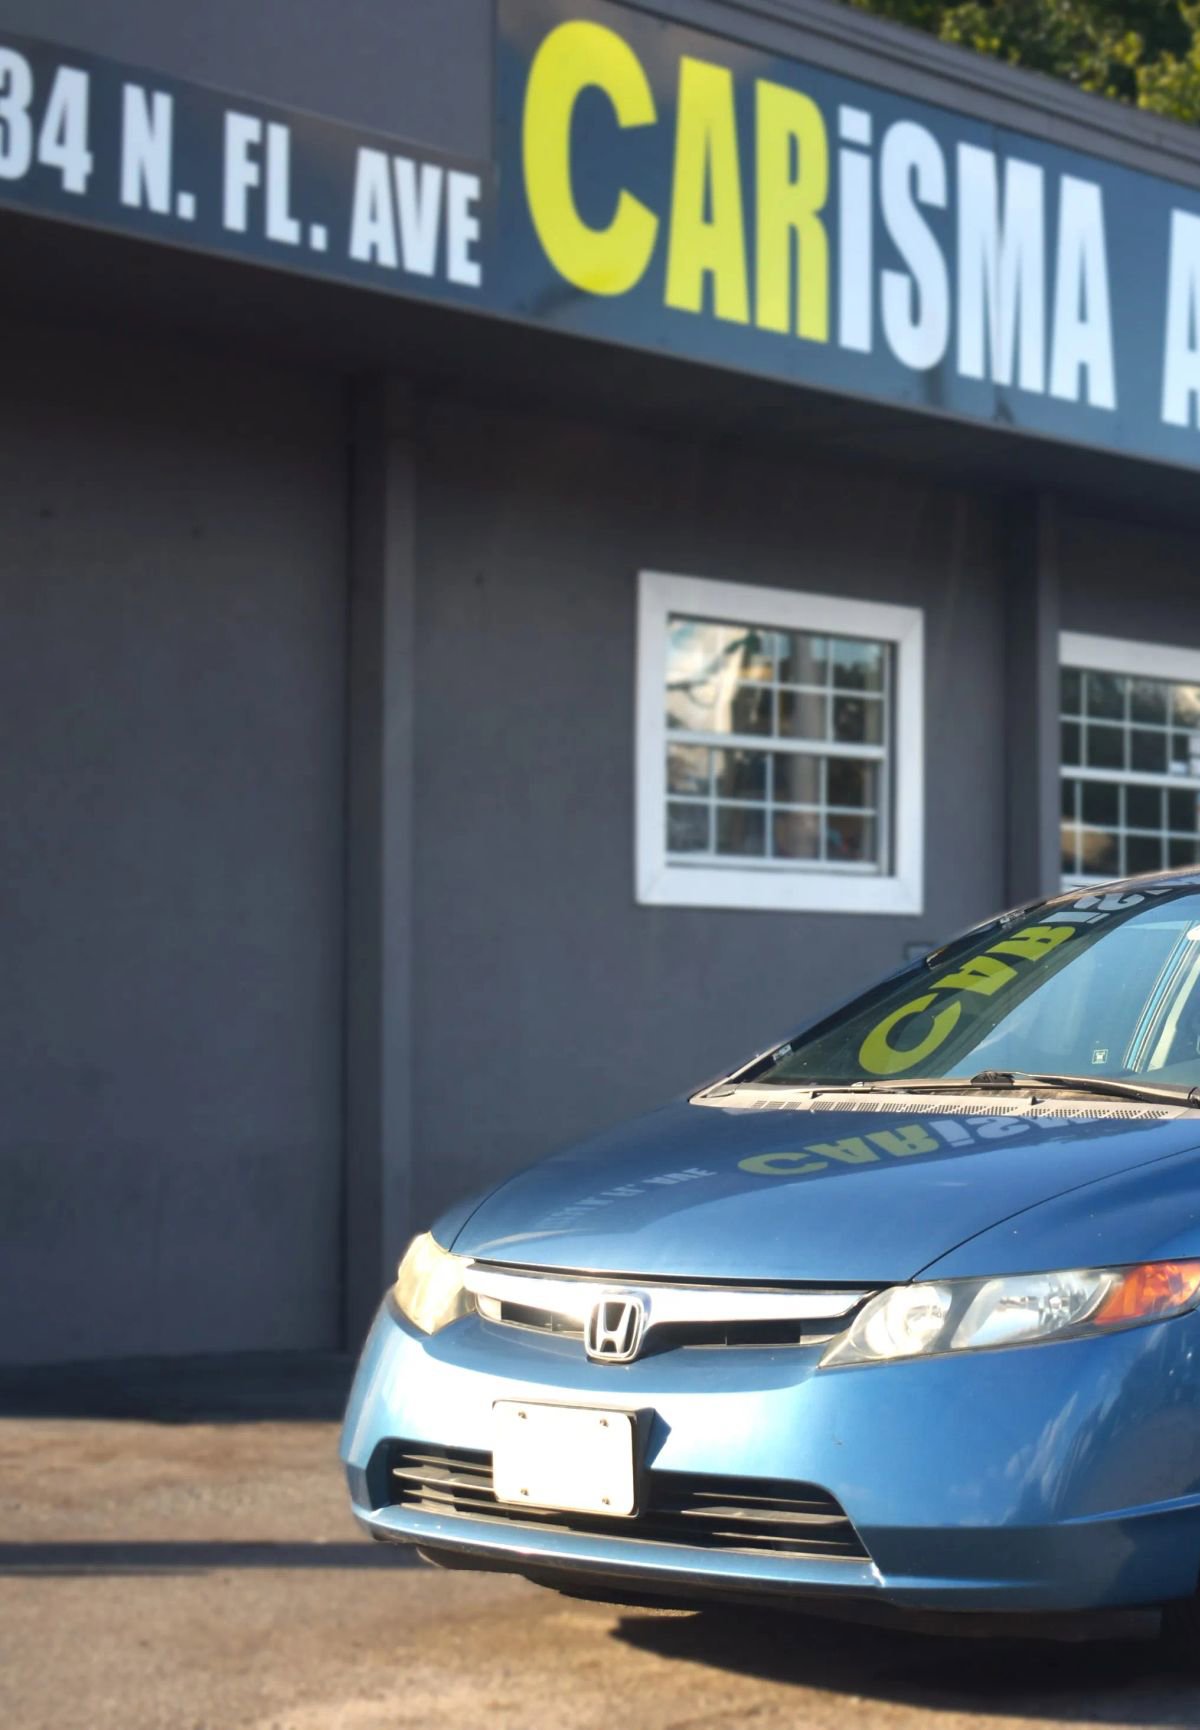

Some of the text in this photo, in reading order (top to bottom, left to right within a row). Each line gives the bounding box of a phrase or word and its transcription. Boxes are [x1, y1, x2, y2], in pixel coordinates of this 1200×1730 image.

[121, 82, 196, 221] N.
[223, 111, 328, 252] FL.
[349, 146, 482, 288] AVE
